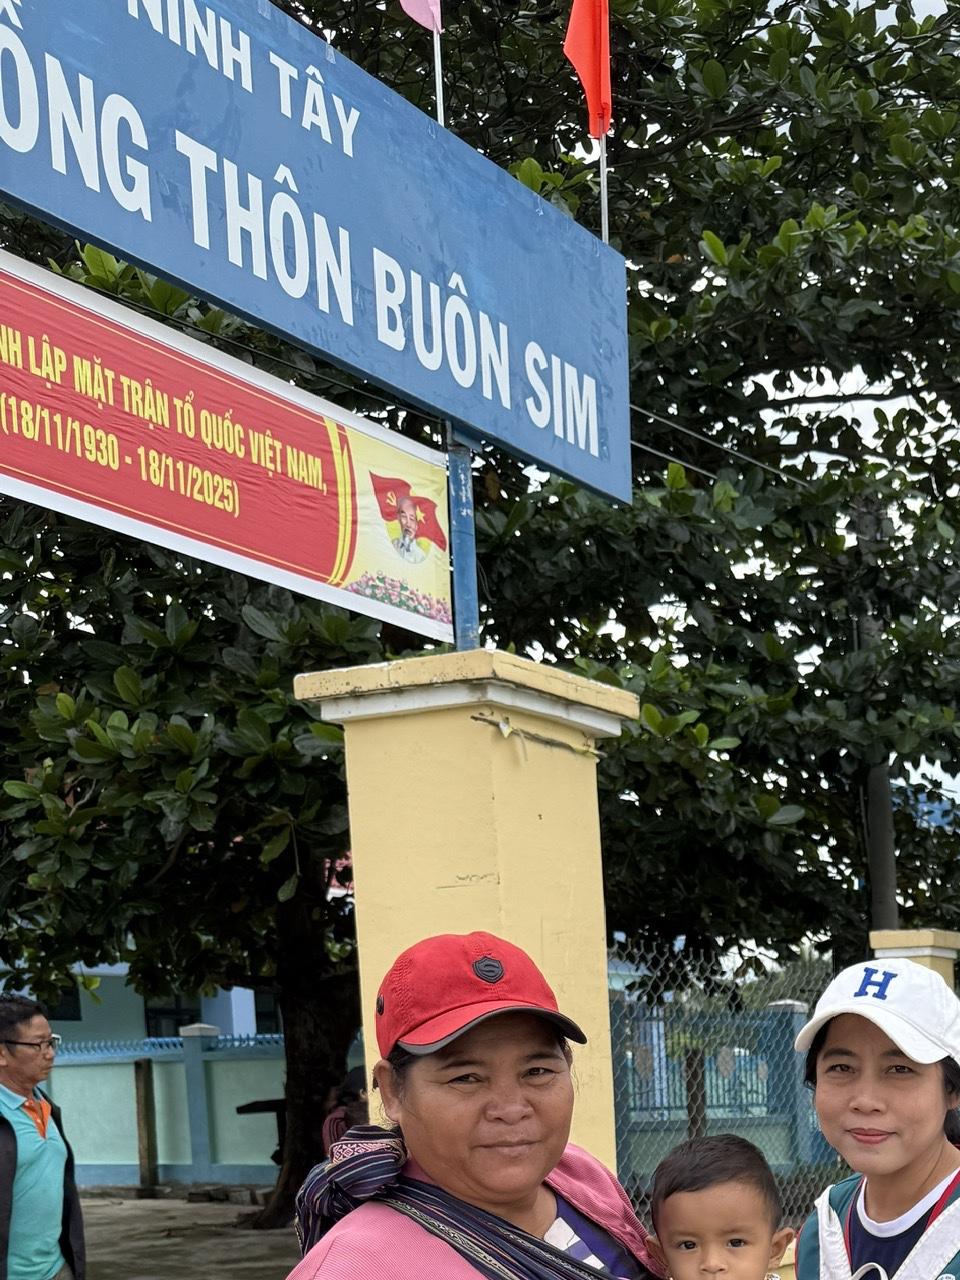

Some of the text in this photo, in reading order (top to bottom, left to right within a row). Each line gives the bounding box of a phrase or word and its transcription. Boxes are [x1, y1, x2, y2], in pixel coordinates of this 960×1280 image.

[269, 51, 361, 158] TÂY
[175, 129, 354, 327] THÔN
[372, 247, 512, 411] BUÔN
[525, 341, 600, 458] SIM
[0, 392, 239, 518] (18/11/1930 - 18/11/2025)
[28, 334, 67, 390] LẬP
[72, 355, 116, 410] MẶT
[119, 378, 170, 430] TRẬN
[173, 390, 195, 438] TỔ
[200, 409, 245, 459] QUỐC
[249, 429, 282, 477] VIỆT
[287, 445, 327, 496] NAM,
[853, 966, 898, 1000] H
